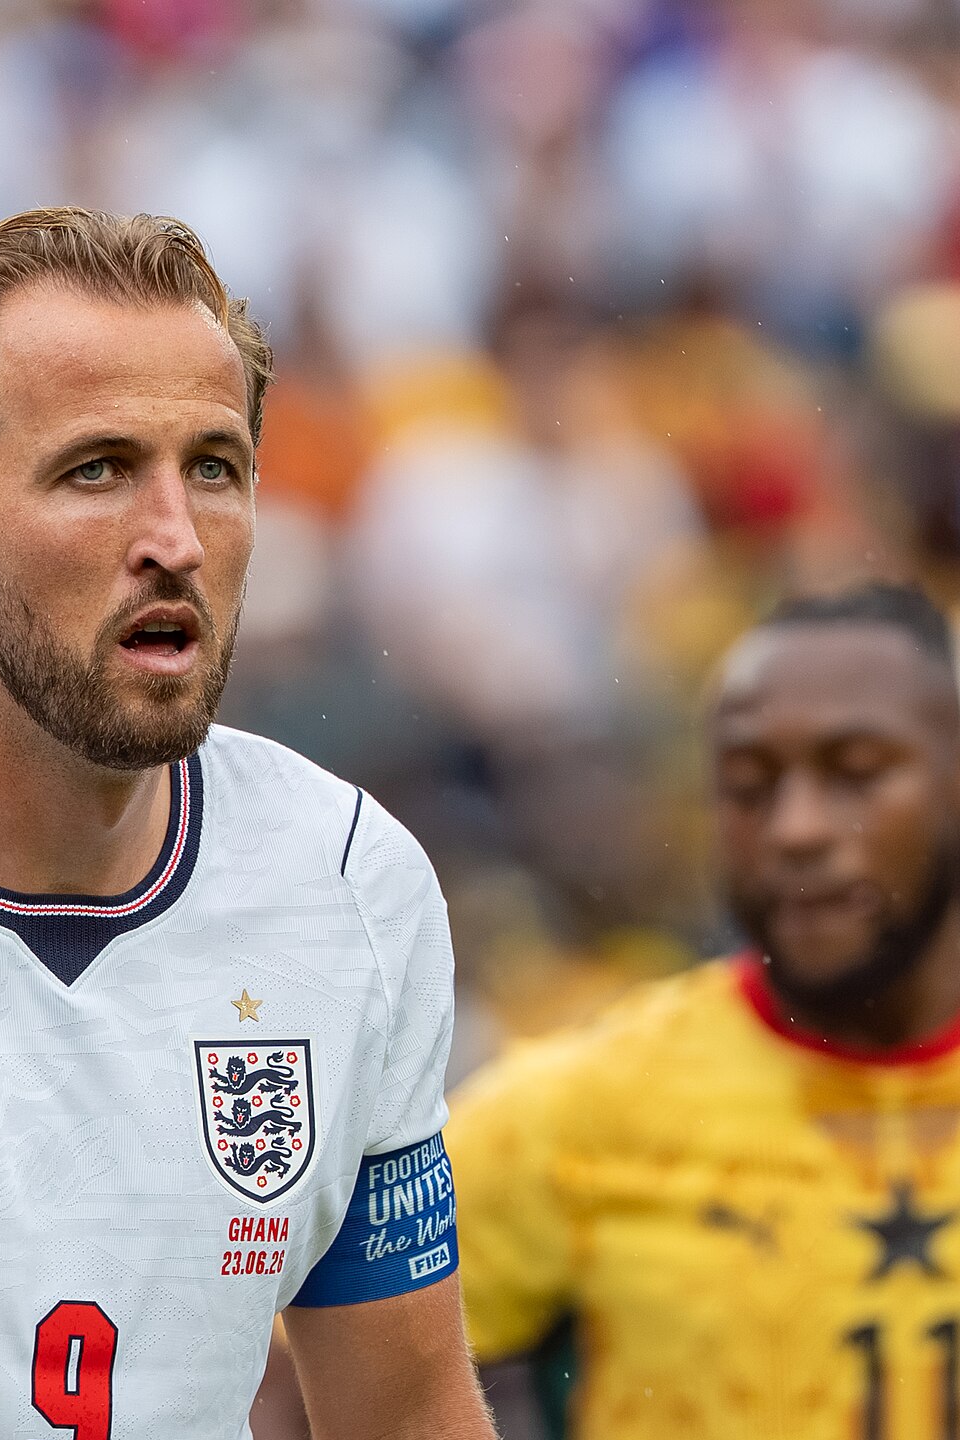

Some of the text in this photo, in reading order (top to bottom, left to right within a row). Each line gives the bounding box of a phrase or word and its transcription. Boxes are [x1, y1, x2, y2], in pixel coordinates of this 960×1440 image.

[368, 1133, 445, 1190] FOOTBALL
[368, 1158, 453, 1226] UNITES
[228, 1217, 289, 1243] GHANA
[360, 1228, 412, 1262] the
[221, 1249, 286, 1276] 23.06.26
[413, 1248, 449, 1274] FIFA
